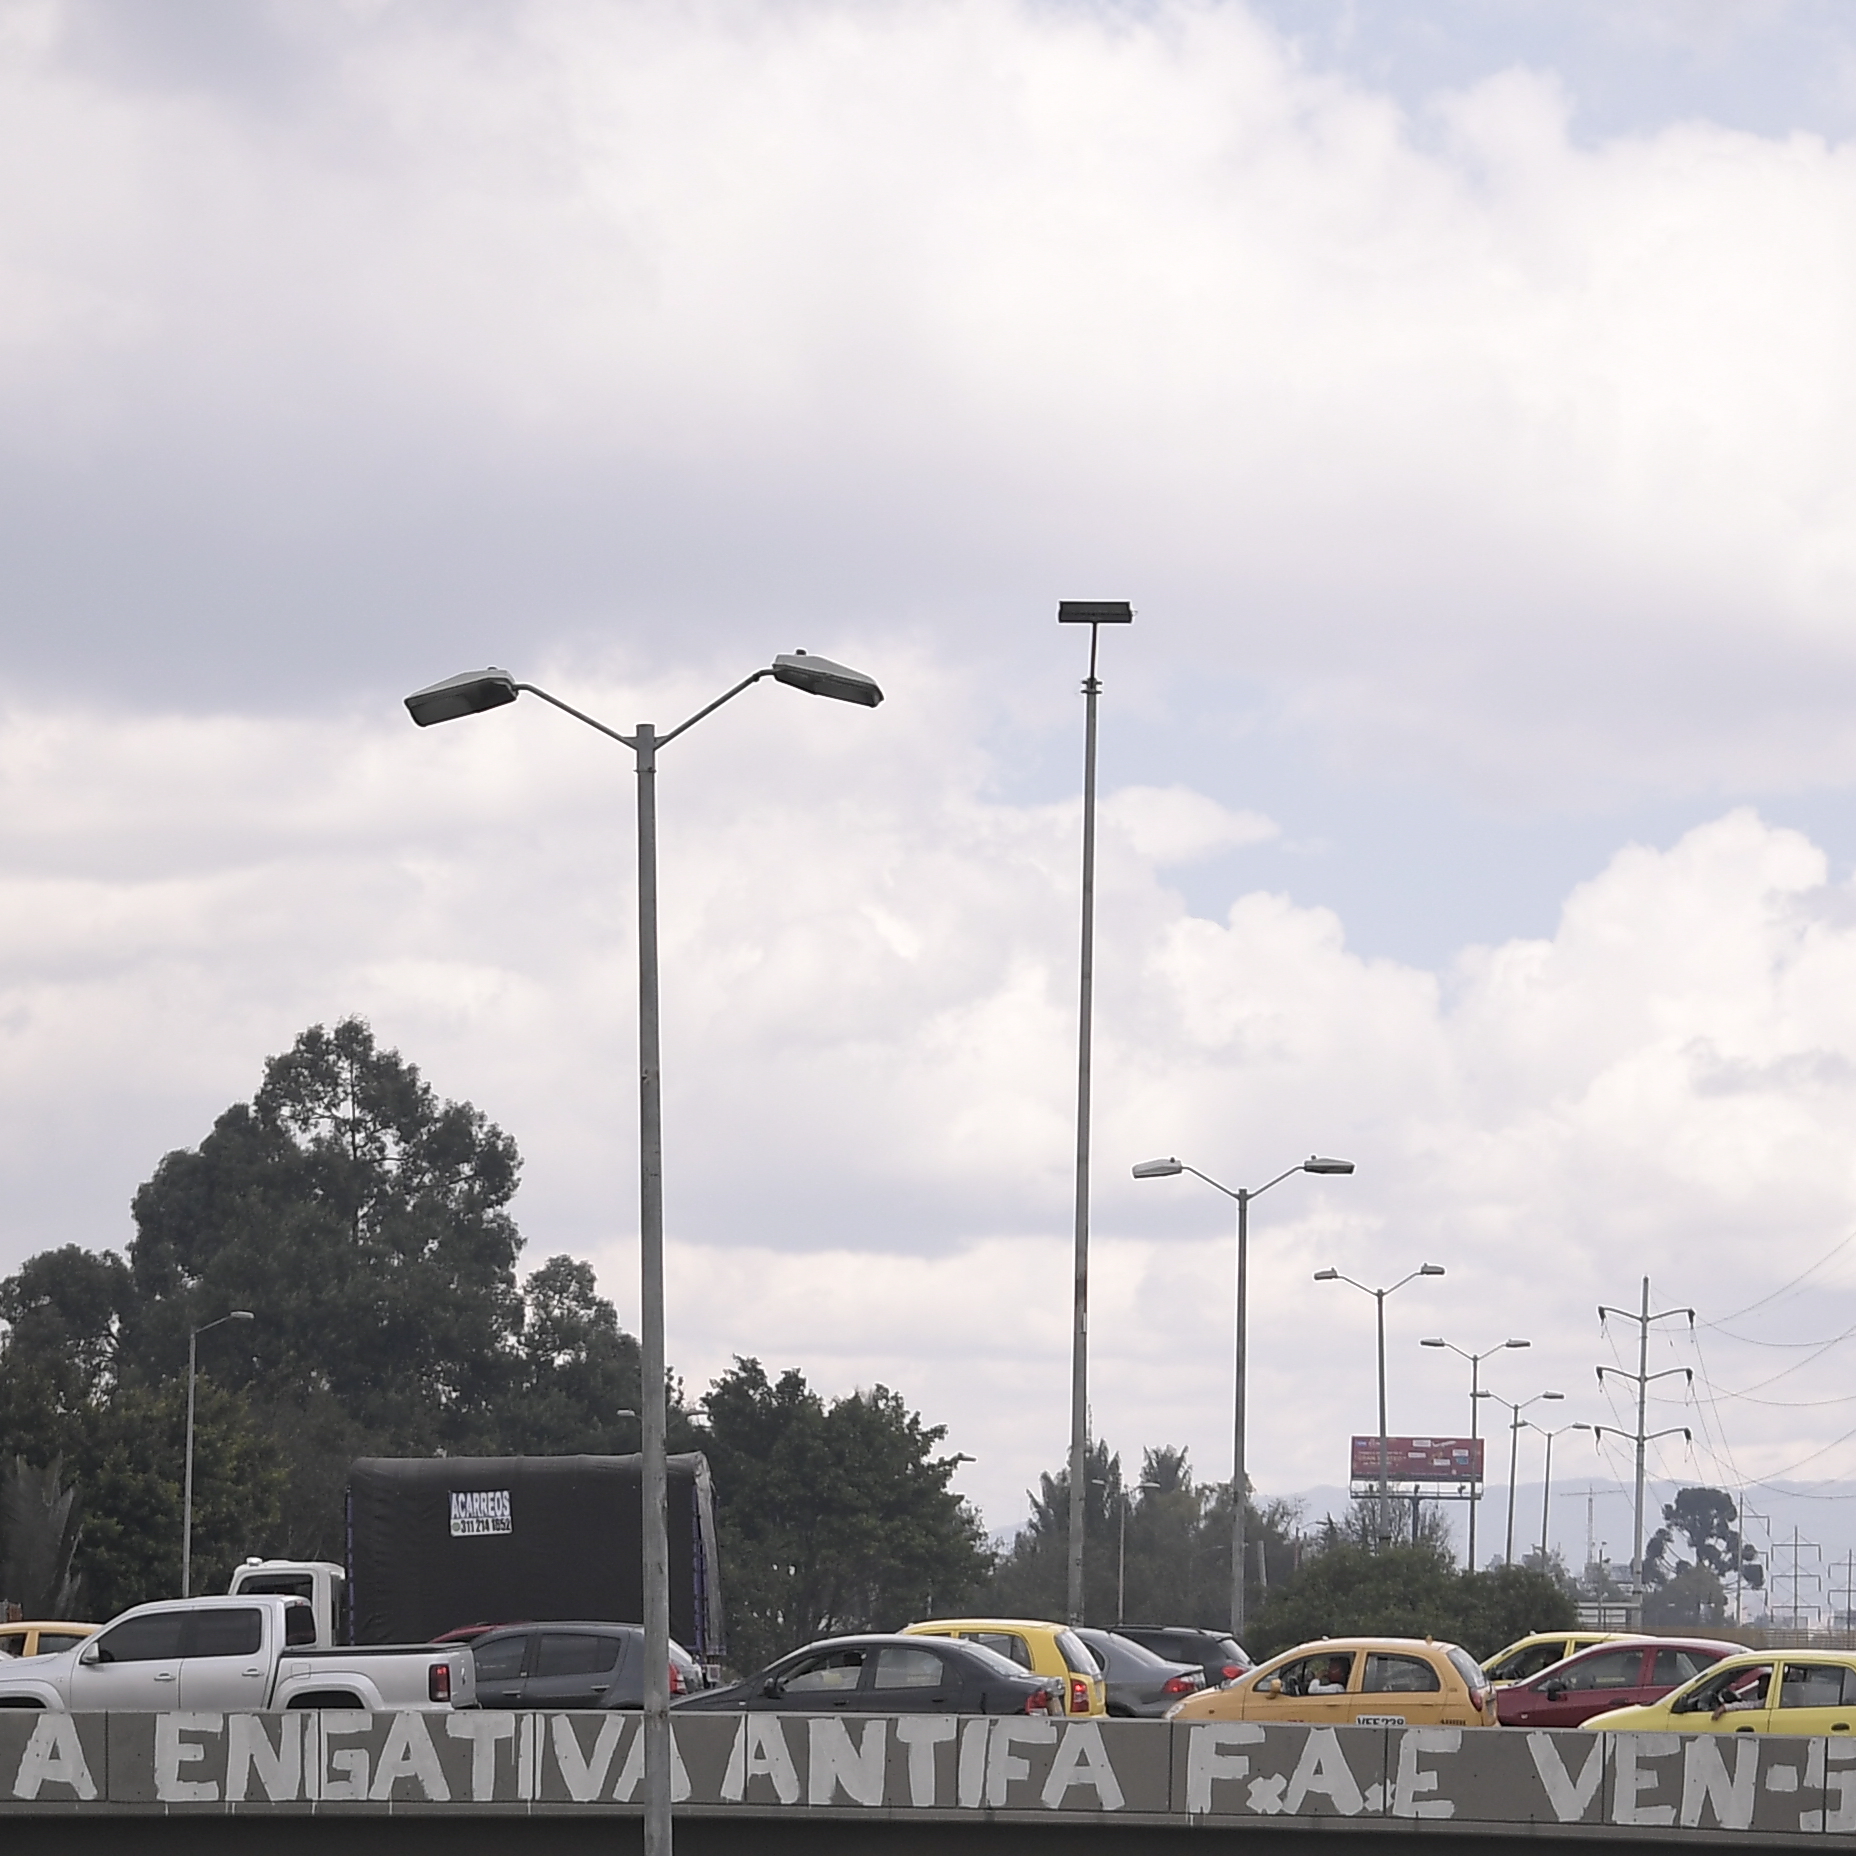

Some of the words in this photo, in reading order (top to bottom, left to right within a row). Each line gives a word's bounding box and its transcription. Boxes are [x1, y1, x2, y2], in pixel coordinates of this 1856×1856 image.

[451, 1491, 510, 1518] ACARREOS
[461, 1520, 474, 1533] 311
[12, 1713, 98, 1800] A
[154, 1711, 692, 1802] ENGATIVA
[719, 1714, 1126, 1810] ANTIFA
